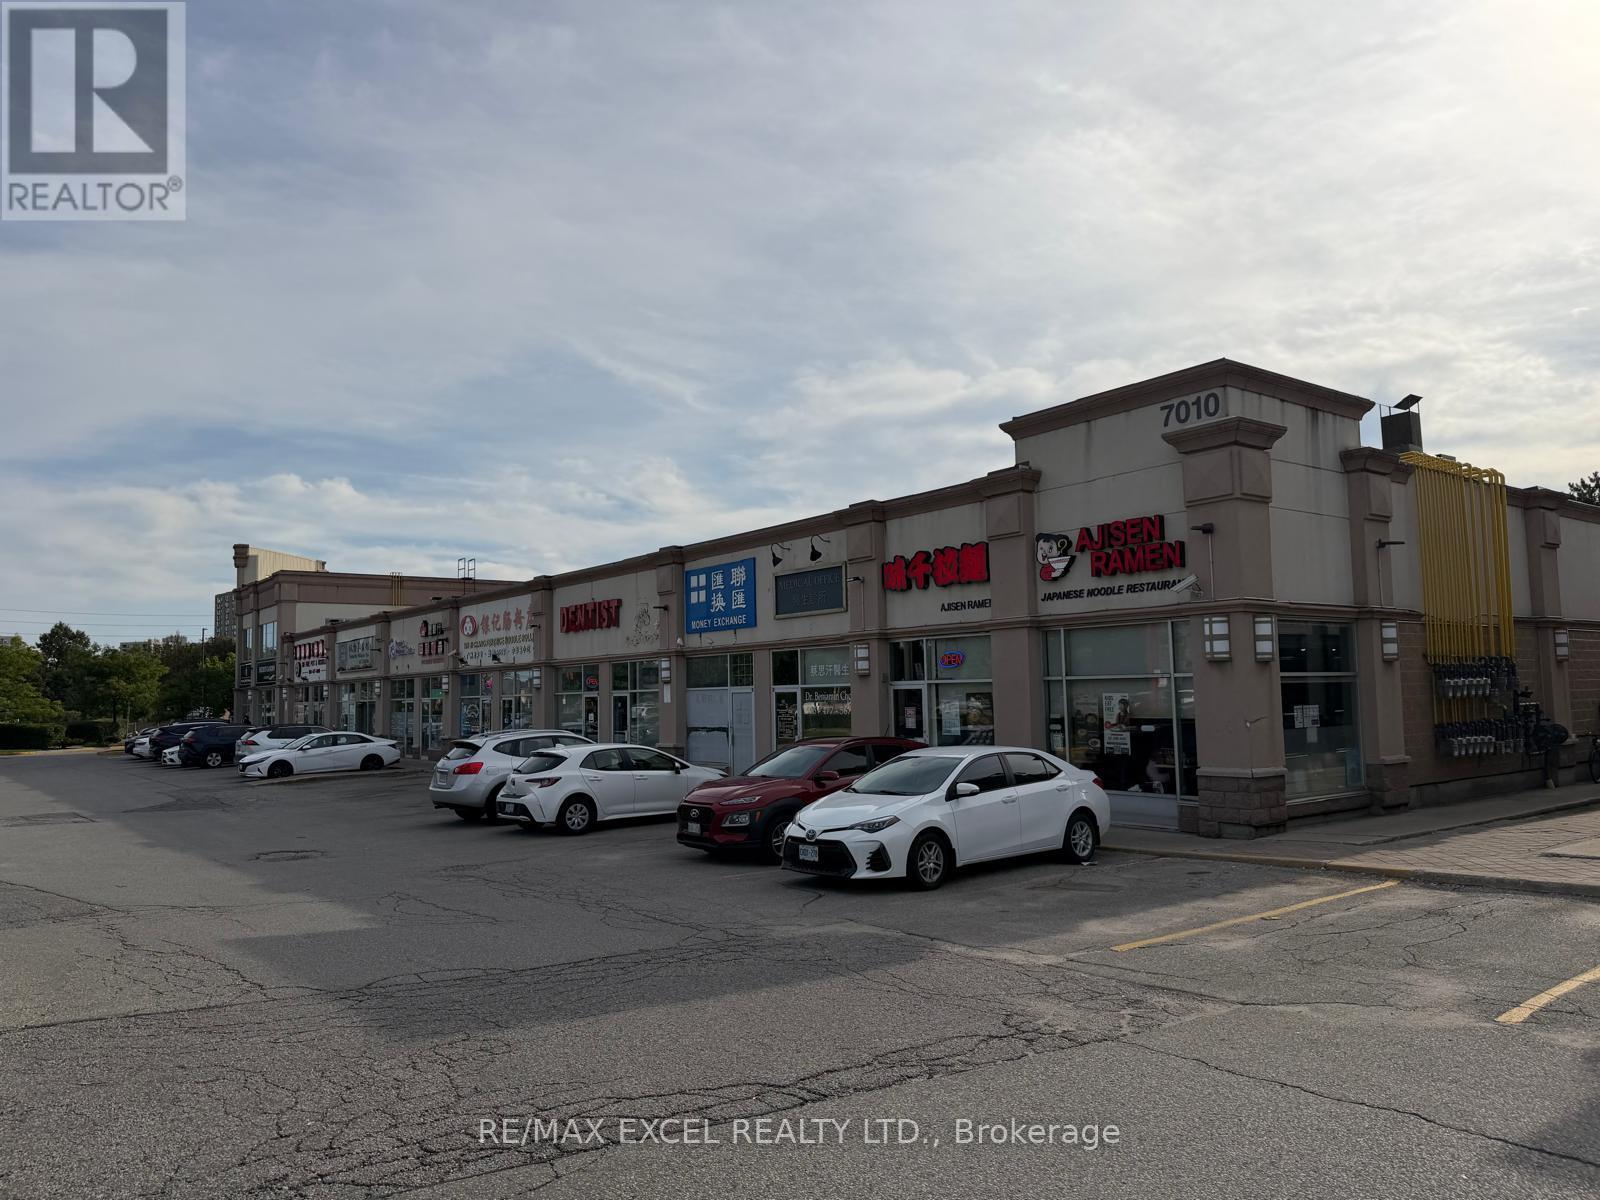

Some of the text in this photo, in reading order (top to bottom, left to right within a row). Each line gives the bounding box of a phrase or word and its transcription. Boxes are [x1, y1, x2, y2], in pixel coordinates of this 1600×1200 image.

[1160, 393, 1220, 428] 7010
[1075, 514, 1165, 552] AJISEN
[1090, 540, 1186, 577] RAMEN
[1041, 588, 1084, 602] JAPANESE
[1086, 584, 1125, 598] NOODLE
[560, 599, 622, 633] DENTIST
[940, 601, 966, 613] AJISEN
[691, 614, 747, 630] MONEY EXCHANGE
[941, 654, 962, 665] OPEN
